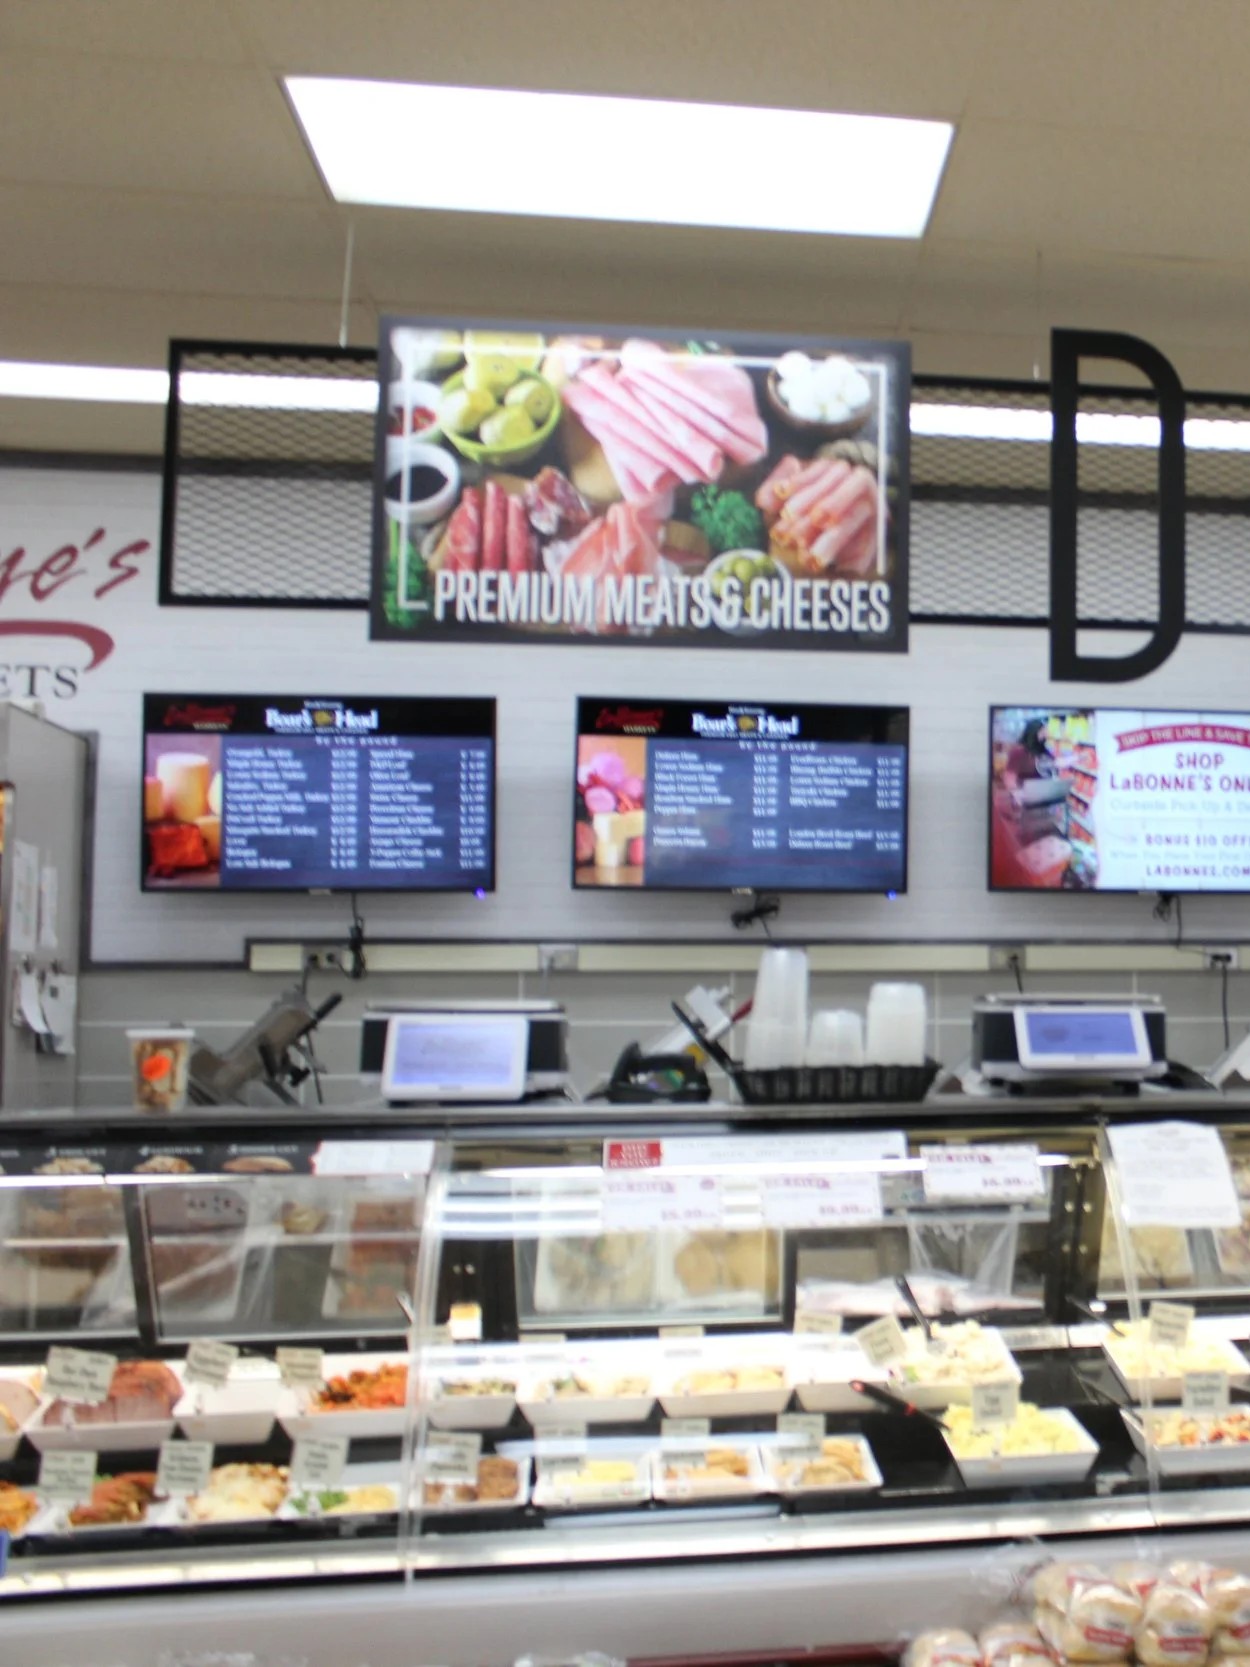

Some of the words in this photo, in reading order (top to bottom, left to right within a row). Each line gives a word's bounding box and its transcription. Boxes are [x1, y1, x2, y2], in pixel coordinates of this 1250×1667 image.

[434, 568, 598, 625] PREMIUM
[602, 573, 711, 629] MEATS
[714, 577, 741, 629] &
[748, 577, 892, 634] CHEESES
[1175, 752, 1225, 770] SHOP
[1109, 773, 1213, 793] LaBONNE'S
